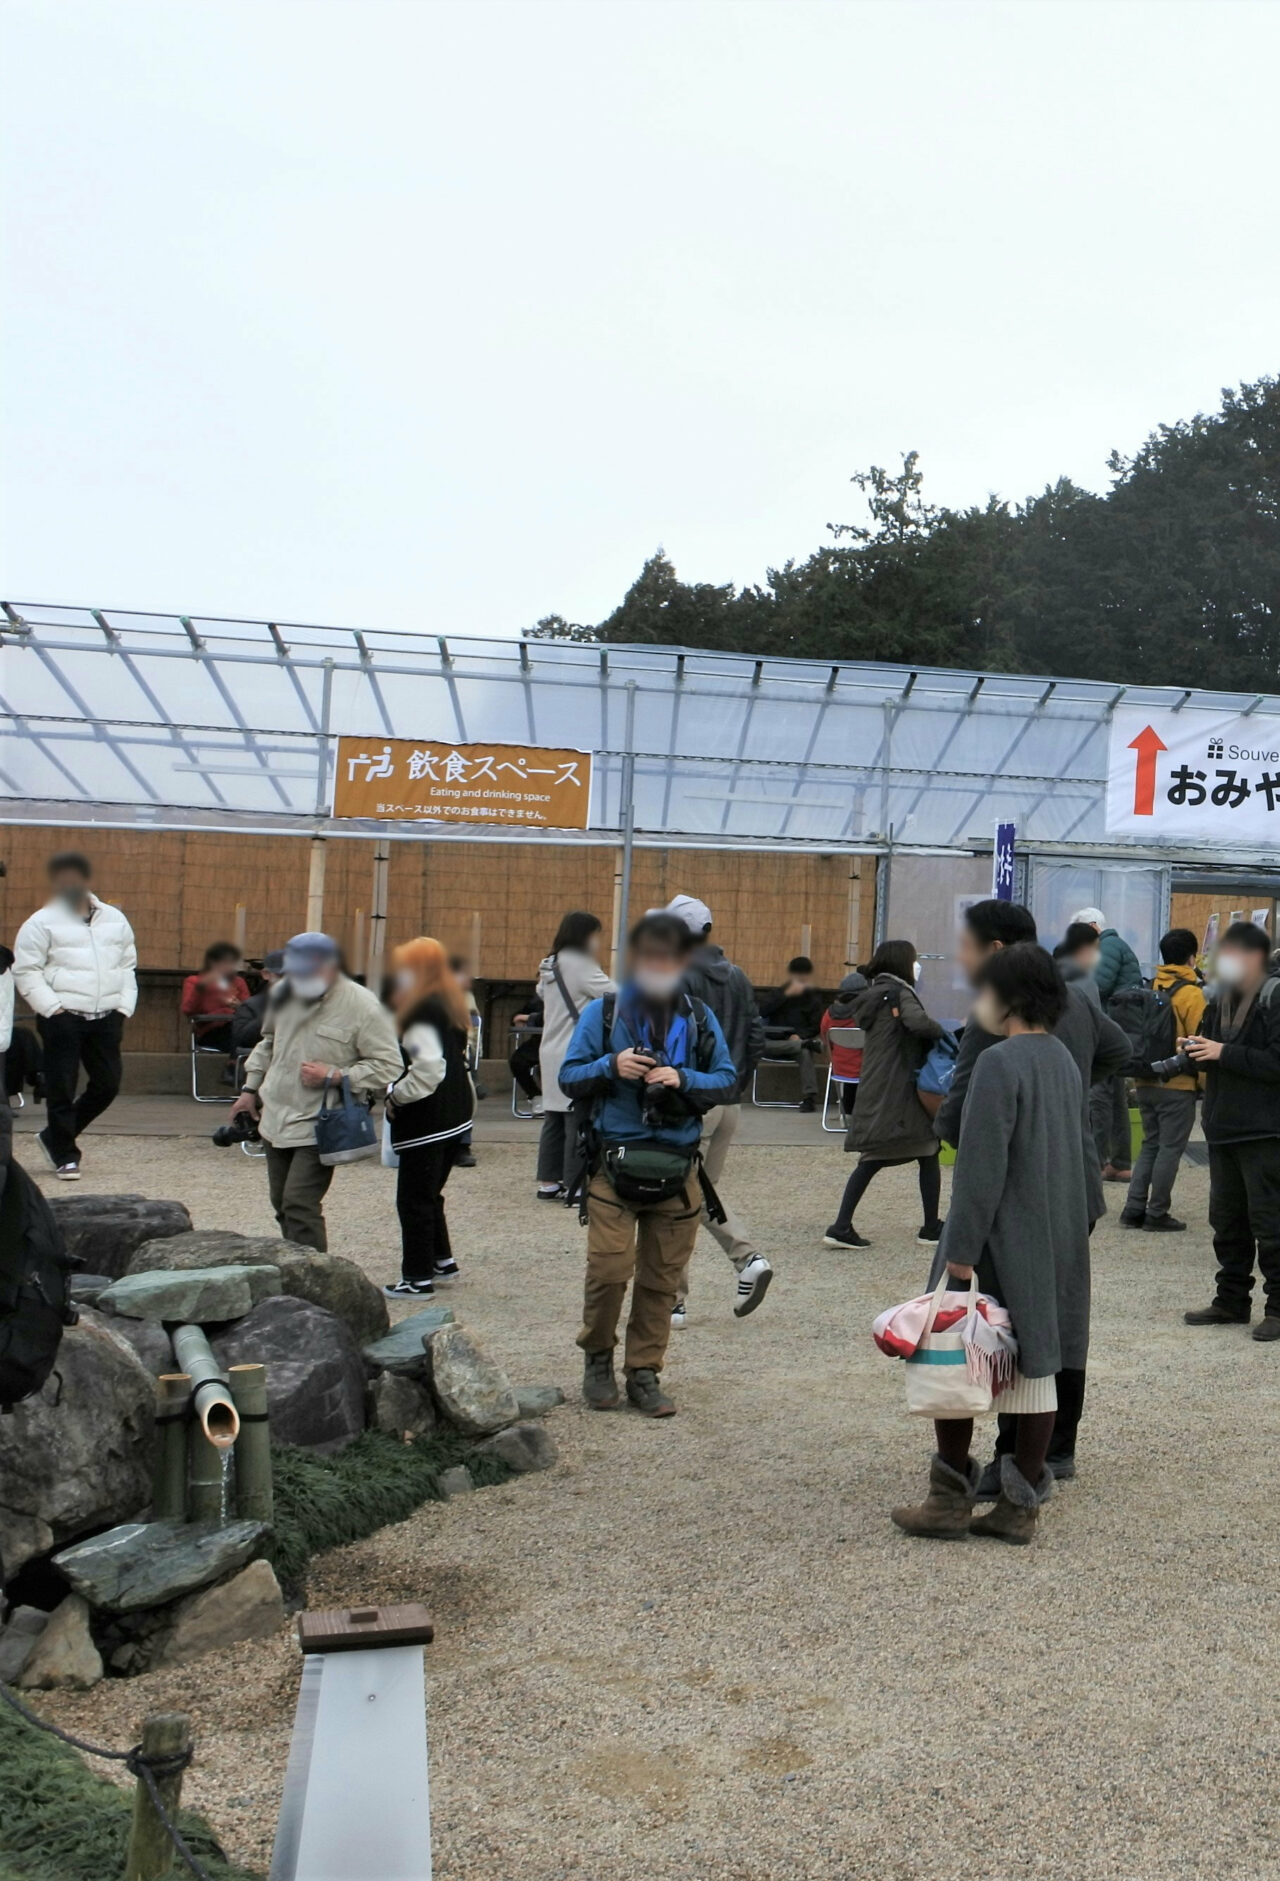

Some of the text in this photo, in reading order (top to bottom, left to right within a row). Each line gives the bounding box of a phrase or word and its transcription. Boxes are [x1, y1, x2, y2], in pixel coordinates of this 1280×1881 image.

[406, 749, 582, 787] 飲食スペース
[430, 786, 551, 803] Eating and drinking space
